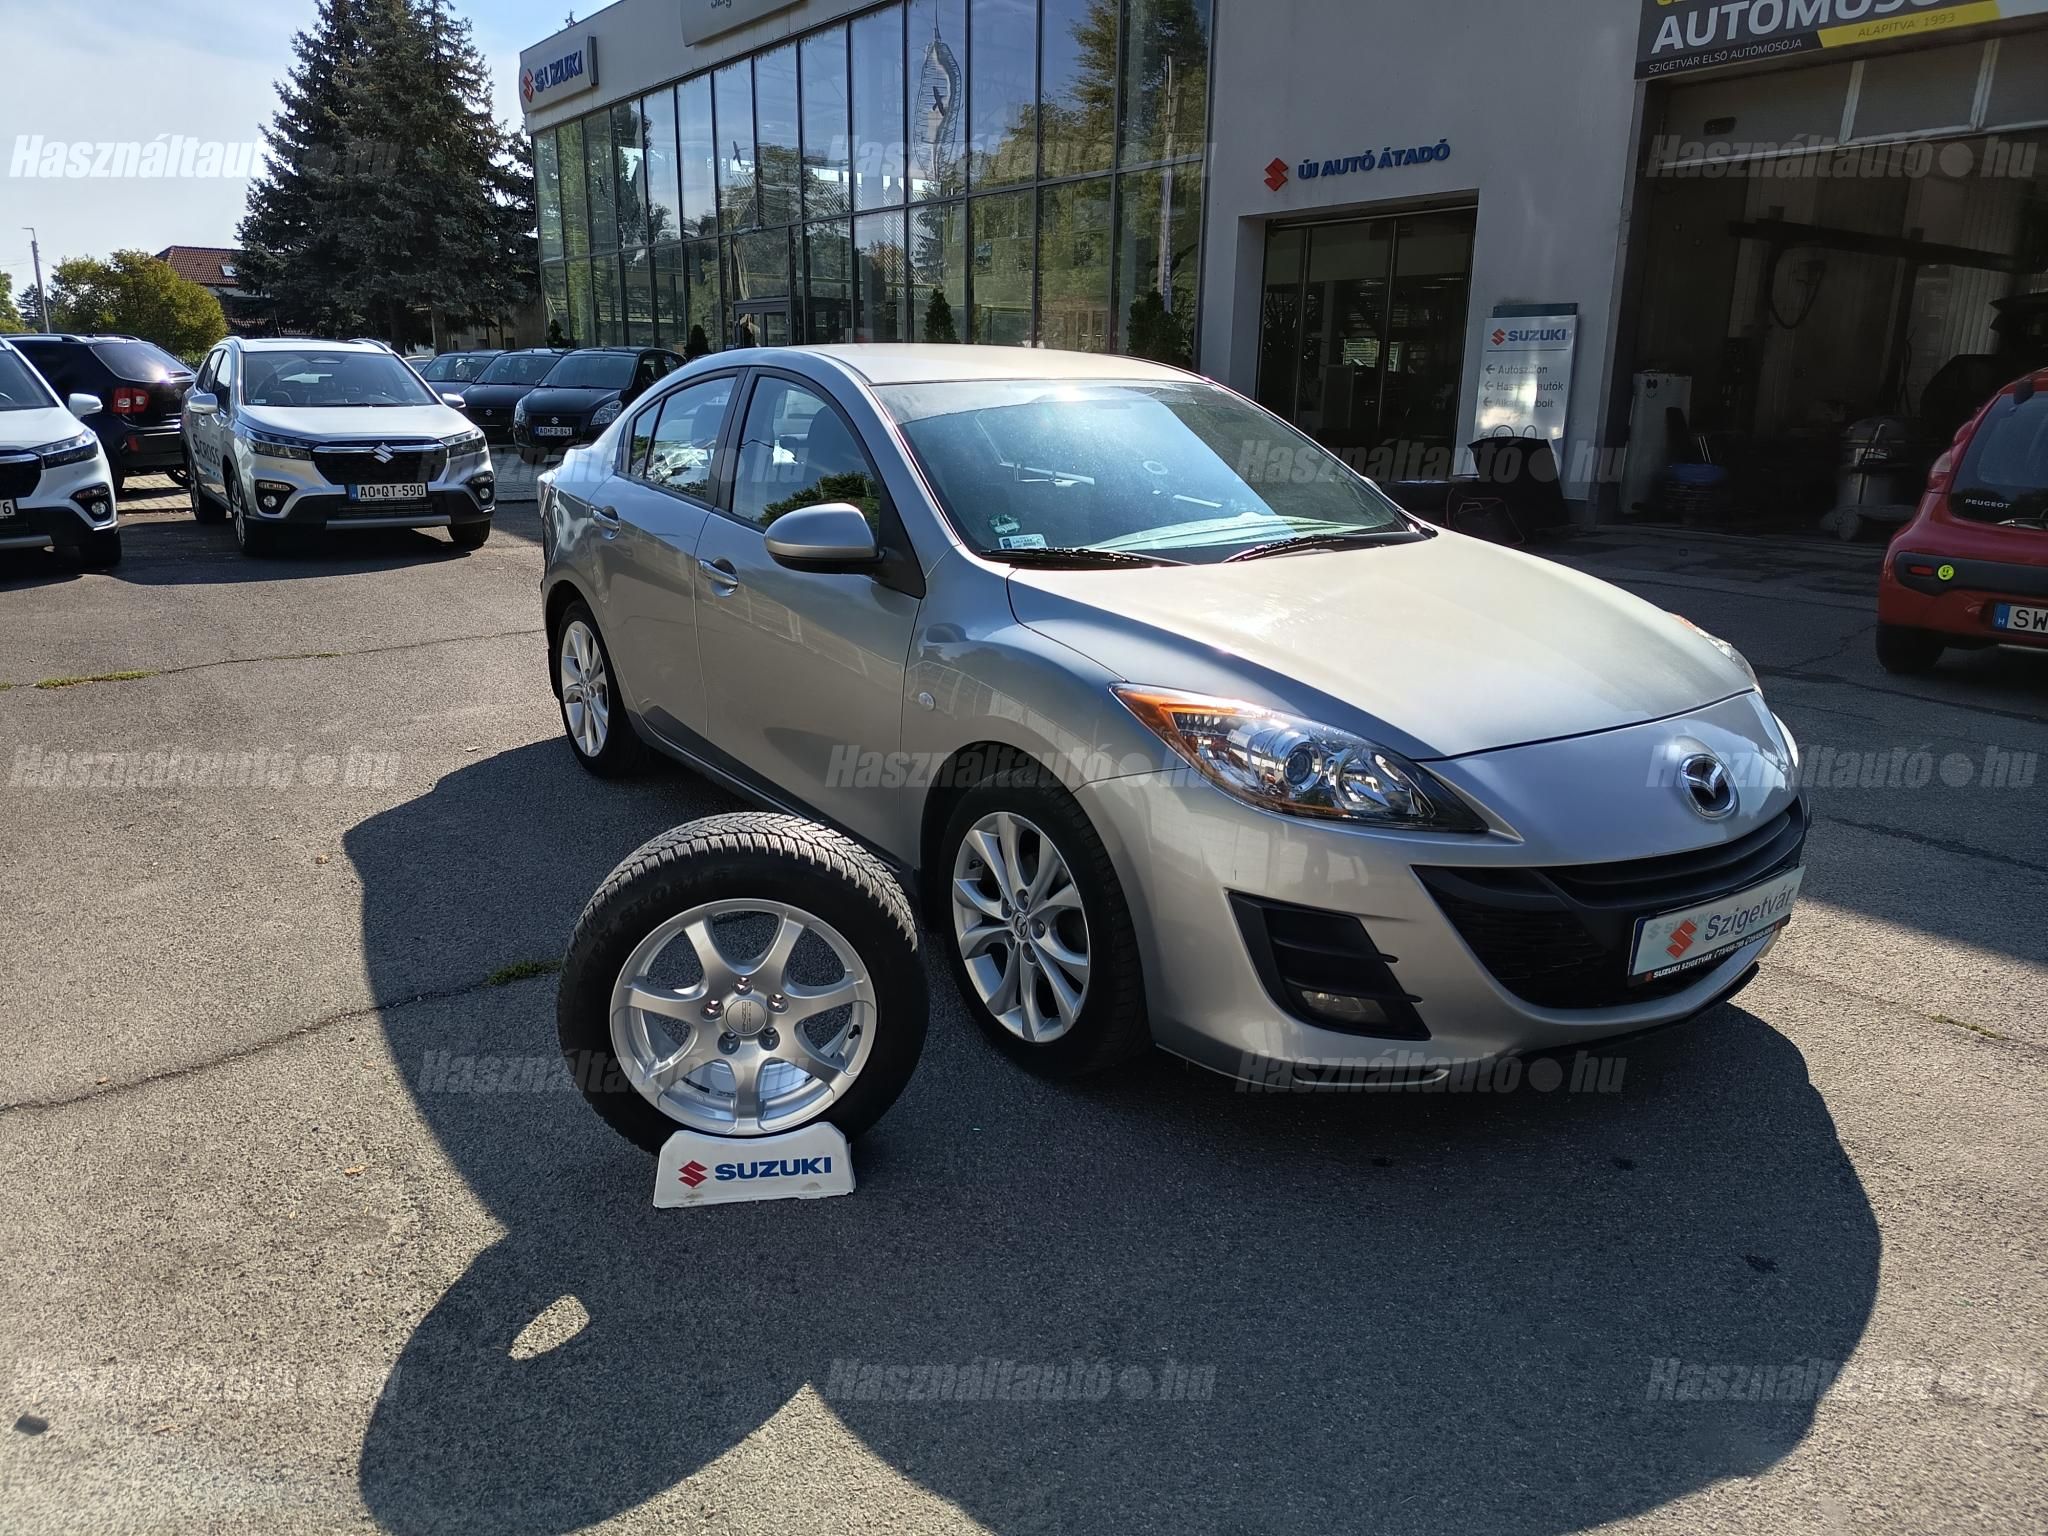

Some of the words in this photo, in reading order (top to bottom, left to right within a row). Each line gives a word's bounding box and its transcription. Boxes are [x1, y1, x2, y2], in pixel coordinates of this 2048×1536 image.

[1924, 13, 1955, 27] 1993
[534, 49, 583, 93] SUZUKI
[1320, 150, 1376, 177] AUTÓ
[1377, 138, 1451, 168] ÁTADÓ
[1508, 329, 1567, 342] SUZUKI
[1965, 499, 2011, 509] PEUGEOT
[1704, 885, 1794, 942] Szigetvár
[1653, 964, 1681, 979] SUZUKI
[715, 1156, 832, 1181] SUZUKI
